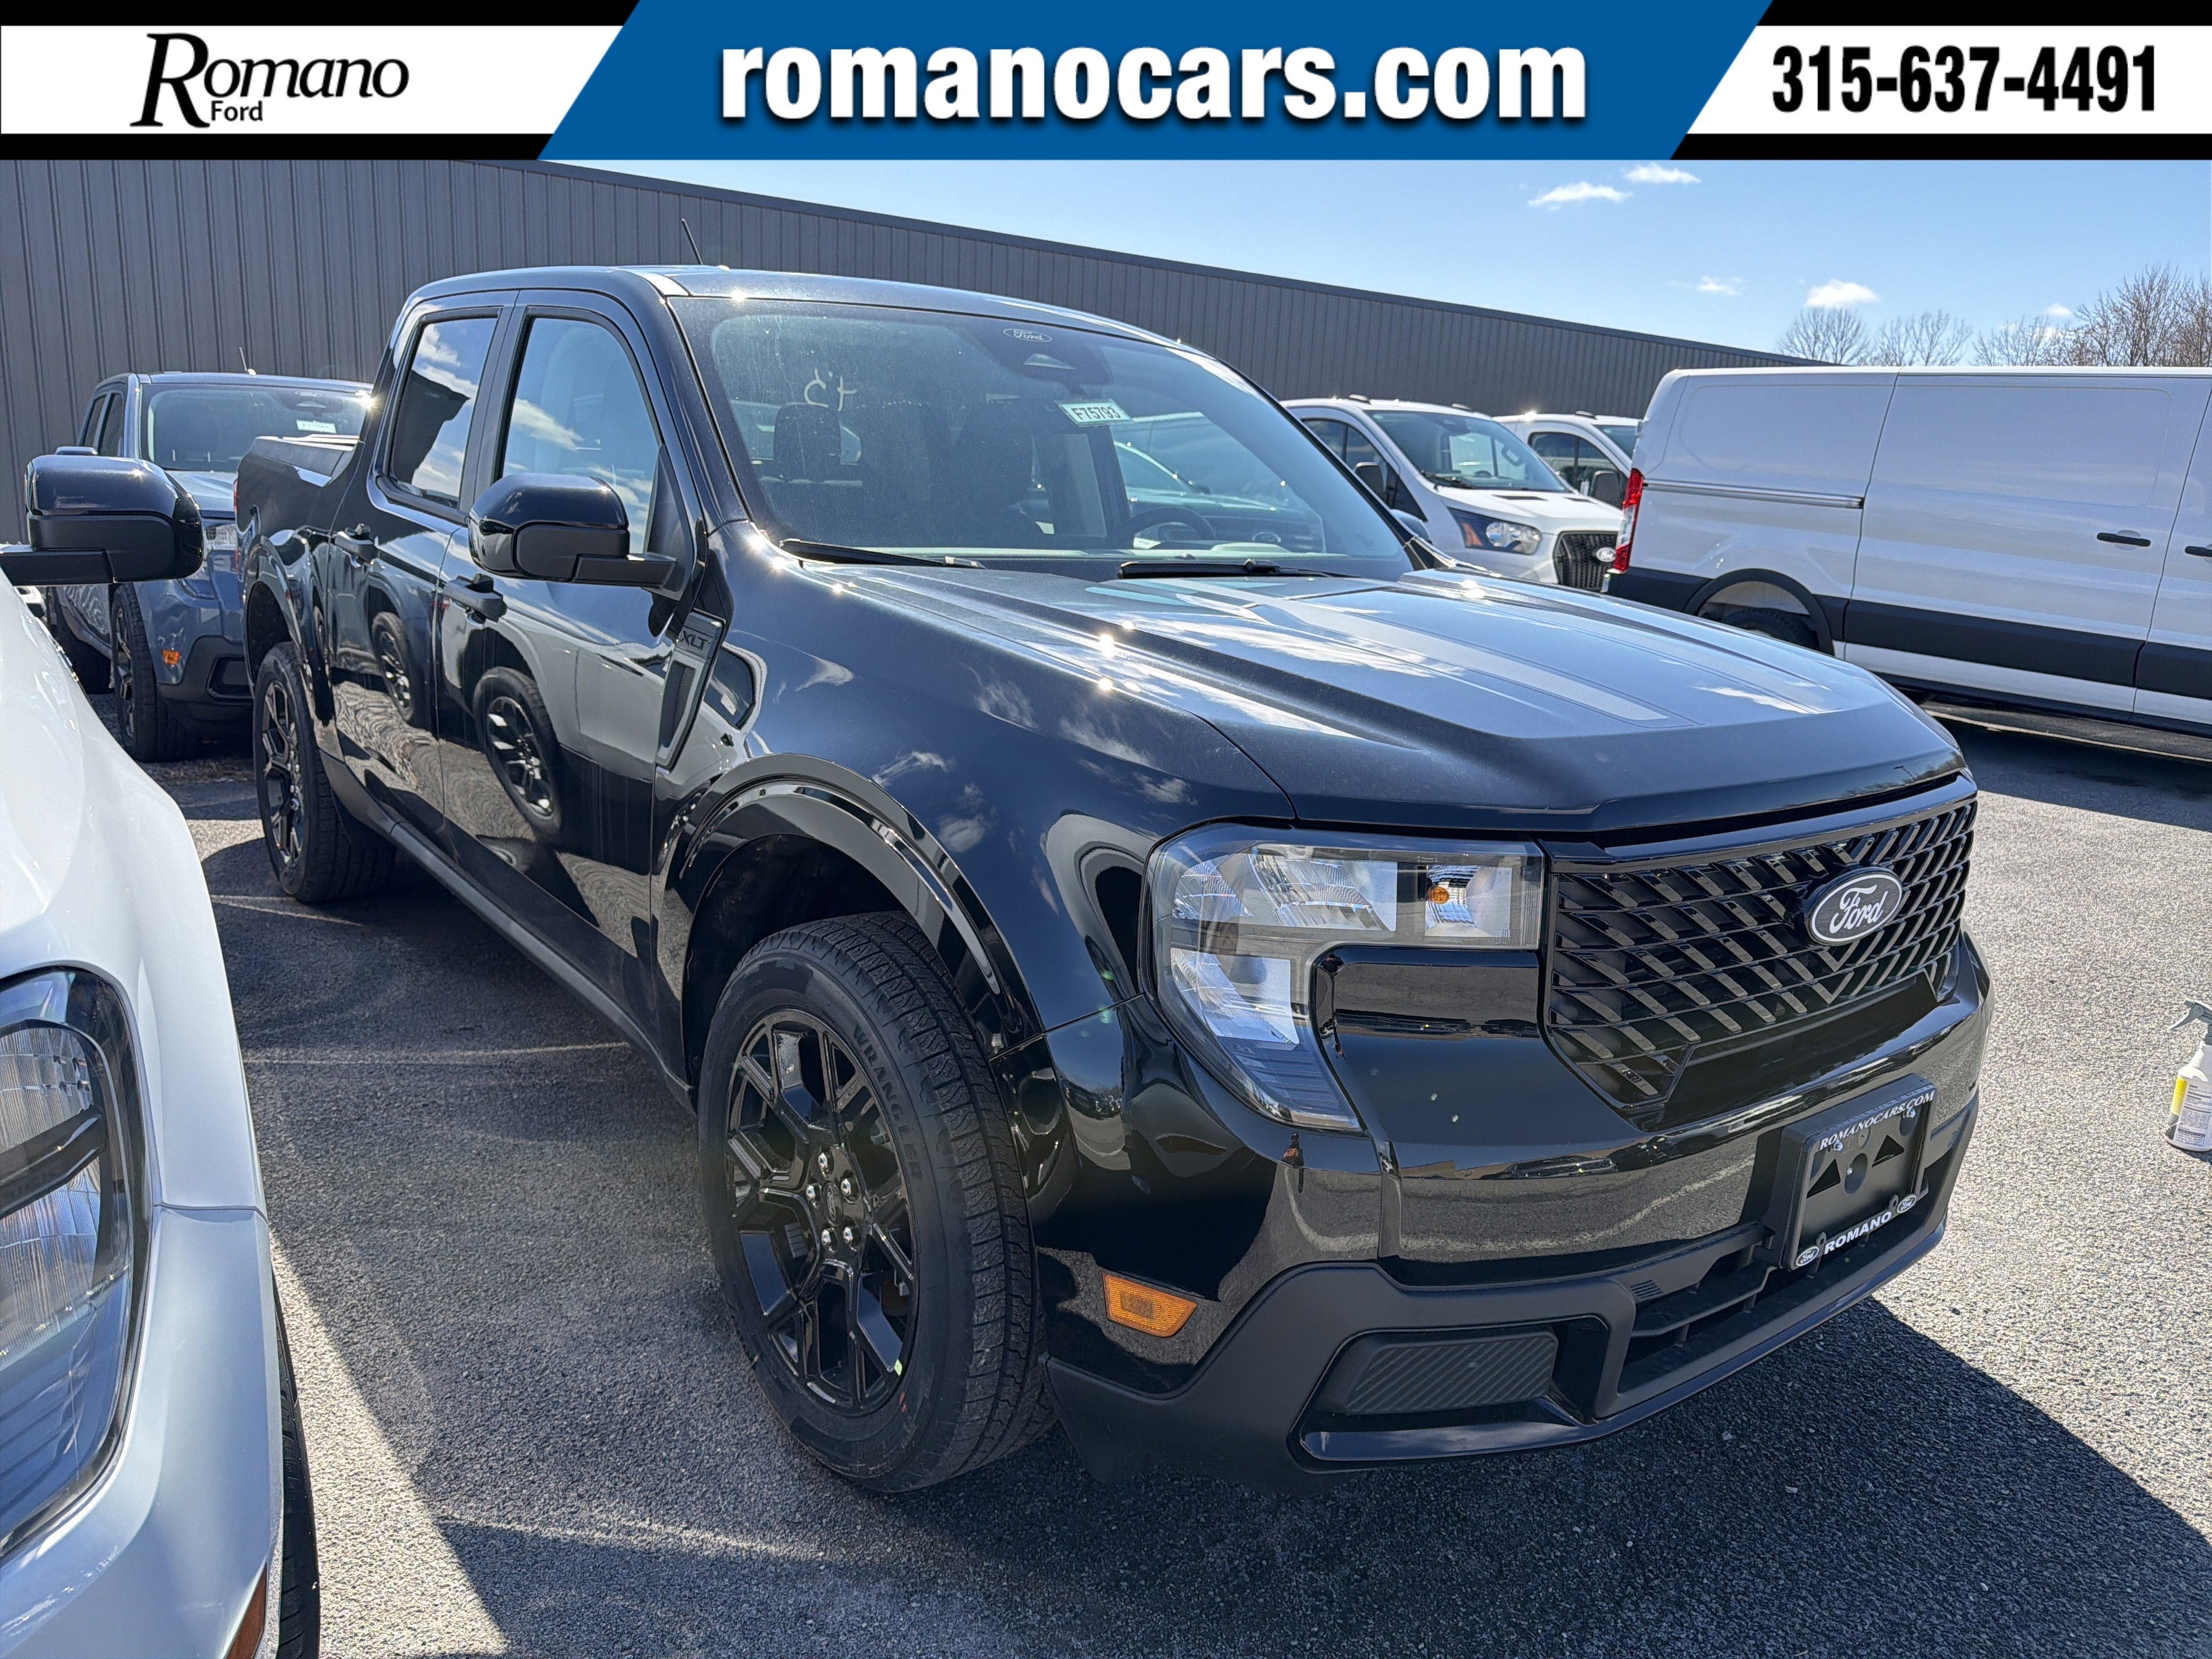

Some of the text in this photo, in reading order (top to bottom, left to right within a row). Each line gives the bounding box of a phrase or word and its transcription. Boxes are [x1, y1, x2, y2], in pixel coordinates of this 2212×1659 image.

[1071, 407, 1121, 420] F75793
[679, 630, 711, 651] XLT
[1829, 884, 1889, 934] Ford
[853, 1023, 922, 1181] WRANGLER
[1819, 1090, 1935, 1151] ROMANOCARS.COM
[1824, 1211, 1892, 1255] ROMANO
